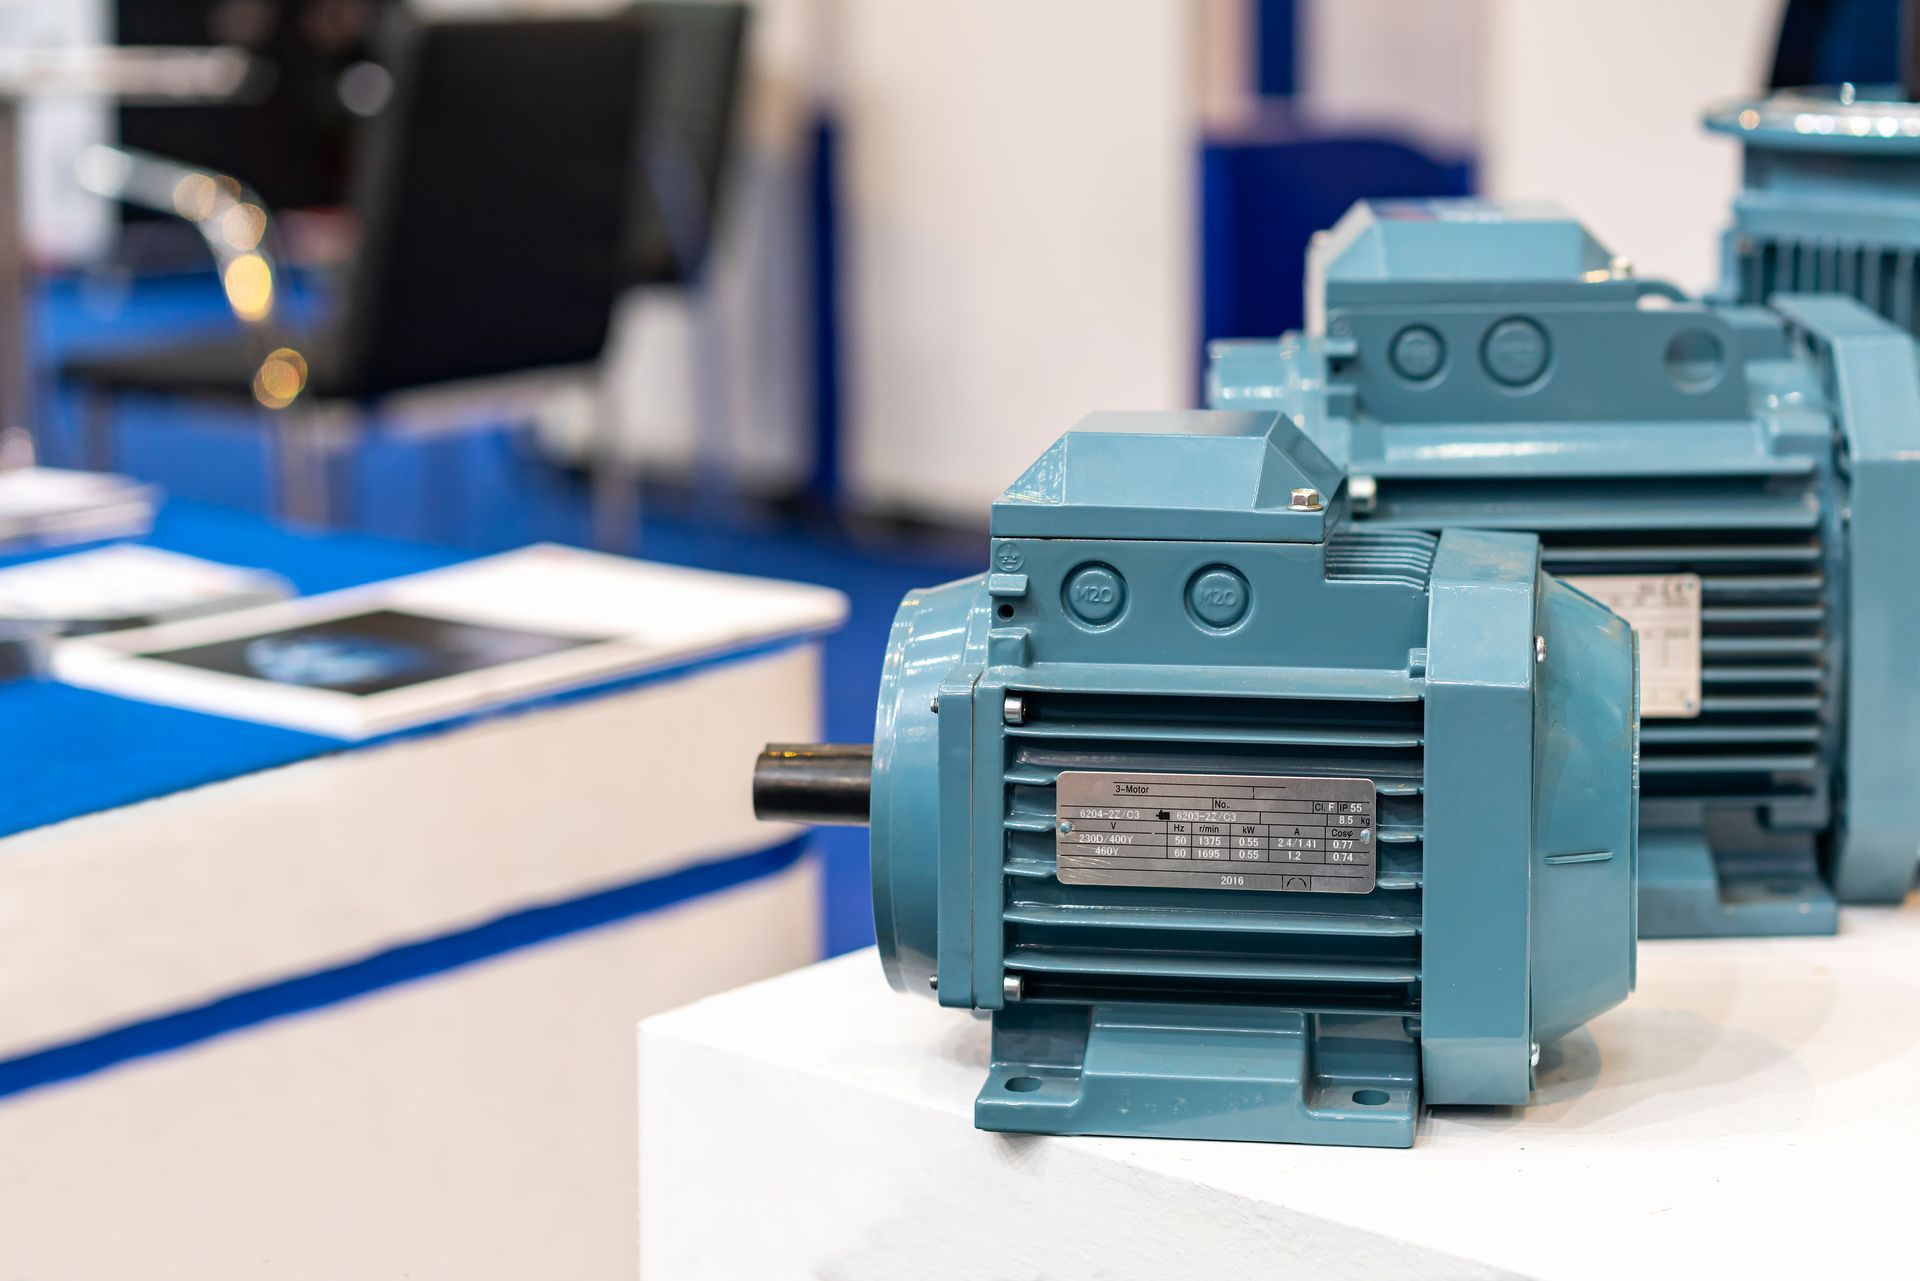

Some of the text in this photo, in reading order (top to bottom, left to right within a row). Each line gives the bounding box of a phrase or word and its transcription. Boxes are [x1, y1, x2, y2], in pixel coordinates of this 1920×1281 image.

[1328, 804, 1335, 812] F
[1339, 804, 1362, 813] IP 55
[1079, 809, 1140, 819] 6204-2Z/C3
[1176, 811, 1237, 822] 6203-2Z/C3
[1110, 822, 1117, 830] V
[1339, 815, 1371, 827] 8.5 kg
[1173, 823, 1185, 832] Hz
[1199, 825, 1219, 834] r/min
[1242, 826, 1256, 835] kW
[1294, 828, 1300, 836] A
[1078, 833, 1134, 844] 230D/400Y
[1174, 836, 1187, 846] 50
[1198, 836, 1221, 847] 1375
[1238, 837, 1259, 847] 0.55
[1277, 838, 1317, 849] 2.4/1.41
[1332, 840, 1353, 850] 0.77
[1095, 846, 1120, 856] 460Y
[1174, 848, 1186, 858] 60
[1197, 849, 1220, 859] 1695
[1238, 850, 1259, 860] 0.55
[1287, 851, 1301, 861] 1.2
[1332, 852, 1353, 863] 0.74
[1220, 875, 1244, 886] 2016
